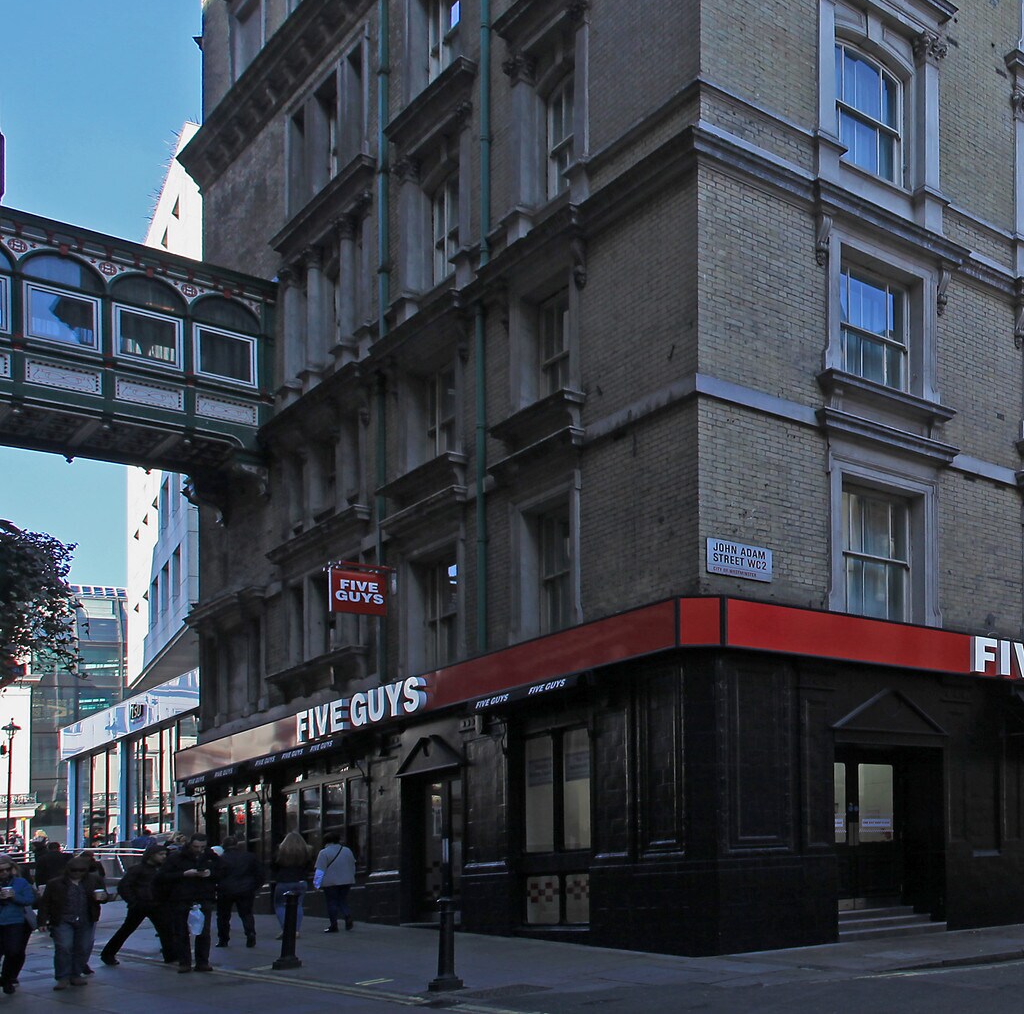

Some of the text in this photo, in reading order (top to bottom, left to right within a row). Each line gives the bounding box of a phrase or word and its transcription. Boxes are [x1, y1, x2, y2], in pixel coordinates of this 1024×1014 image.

[712, 542, 766, 560] JOHN ADAM
[713, 552, 767, 570] STREET WC2
[340, 579, 379, 593] FIVE
[335, 590, 384, 605] GUYS
[528, 678, 566, 695] FIVE GUYS
[475, 693, 509, 709] FIVE GUYS
[296, 676, 425, 743] FIVE GUYS
[291, 748, 304, 758] GUYS
[310, 740, 333, 753] FIVE GUYS
